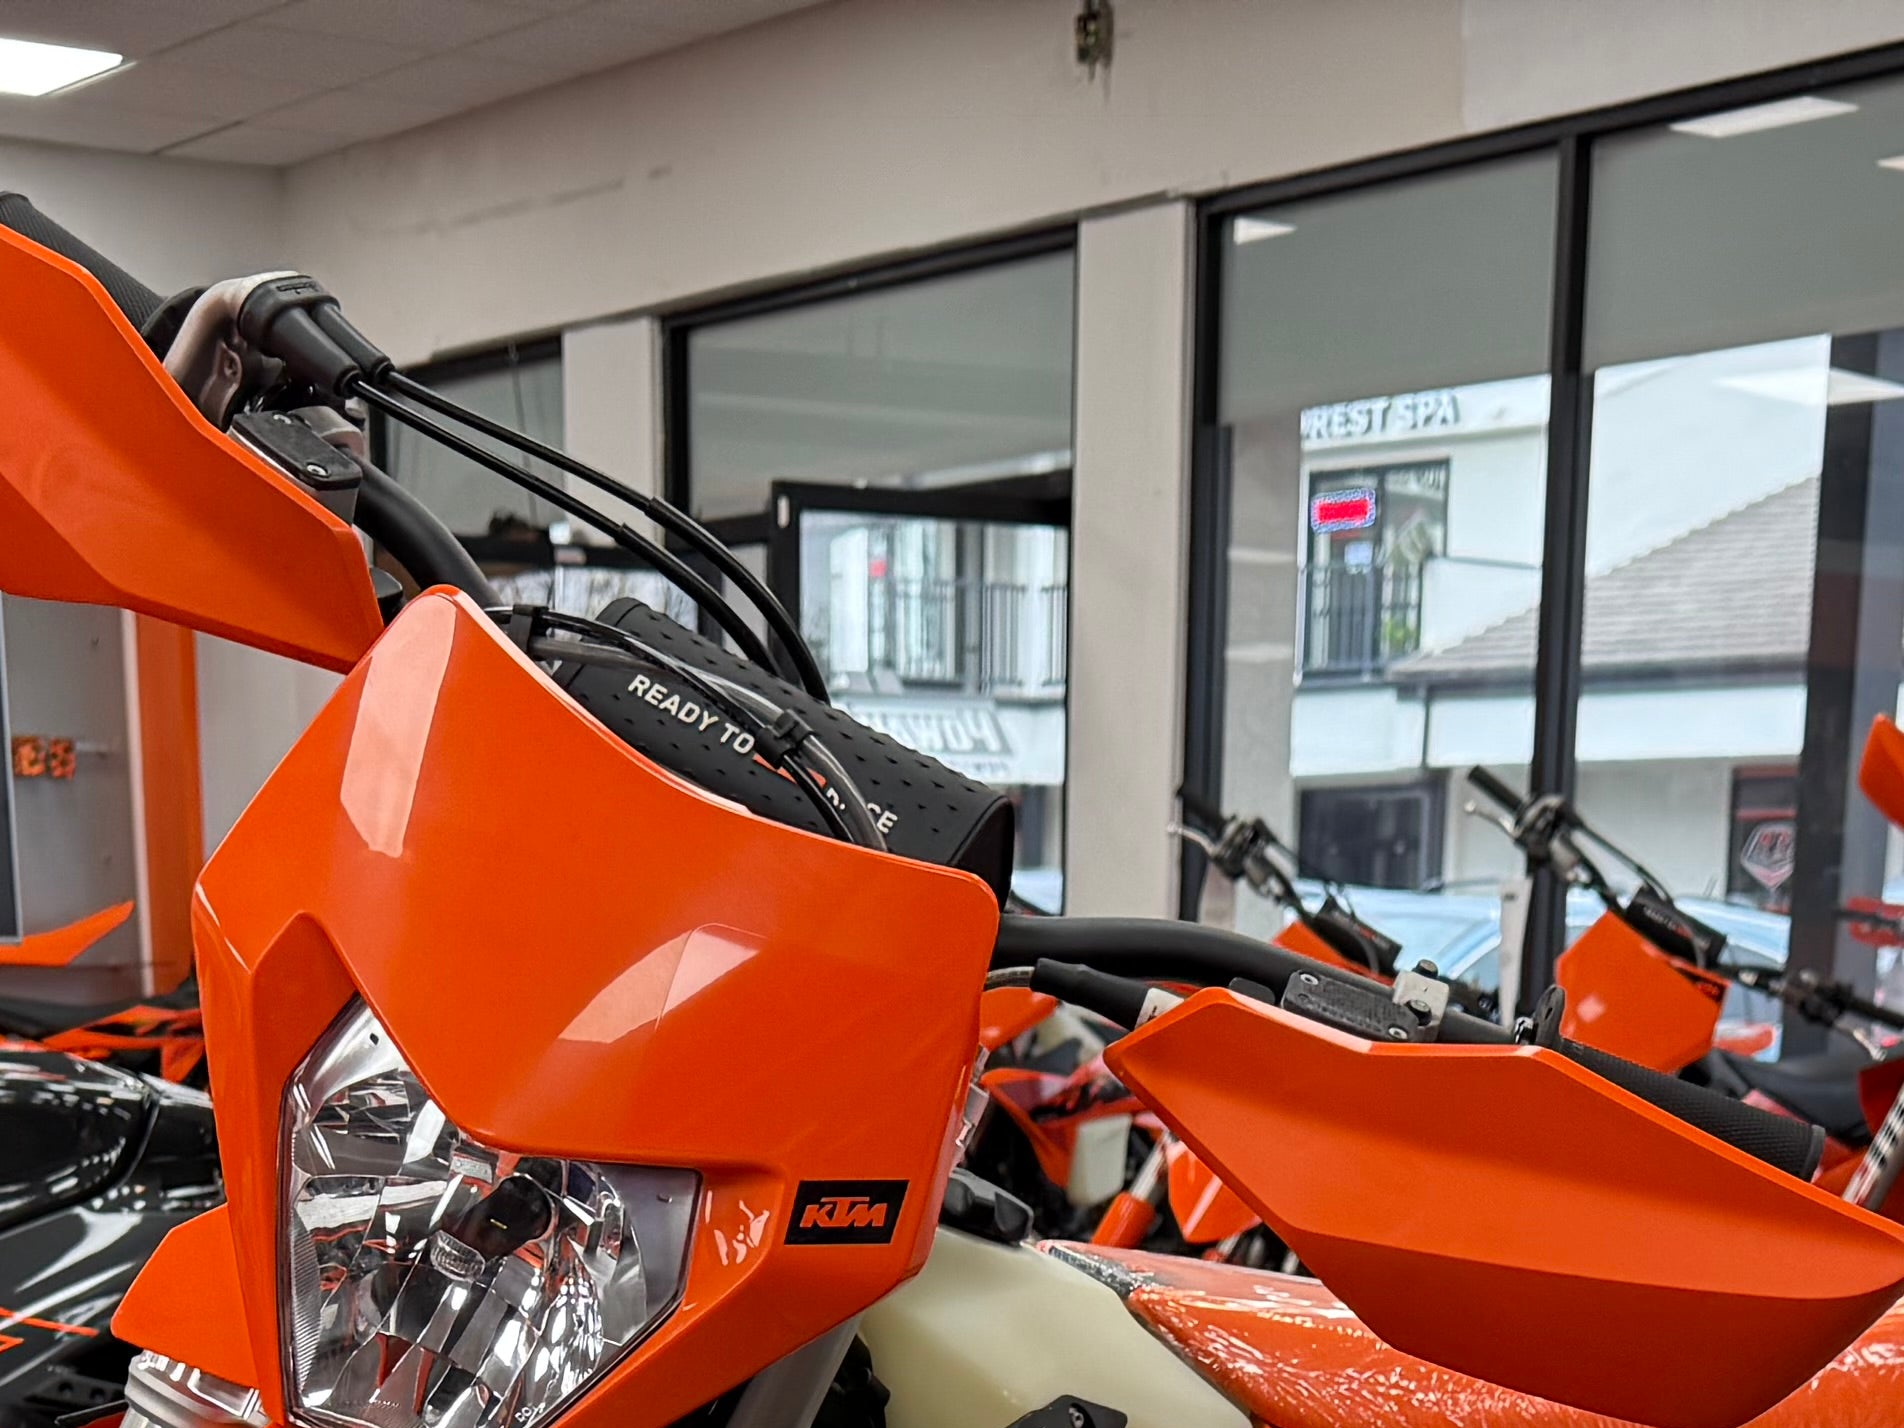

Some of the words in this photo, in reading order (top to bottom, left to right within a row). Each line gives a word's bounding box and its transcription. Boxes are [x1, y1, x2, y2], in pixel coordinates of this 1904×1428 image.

[1302, 396, 1389, 439] REST
[1394, 392, 1459, 430] SPA
[627, 673, 719, 733] READY
[719, 722, 755, 755] TO
[799, 1196, 888, 1228] KTM
